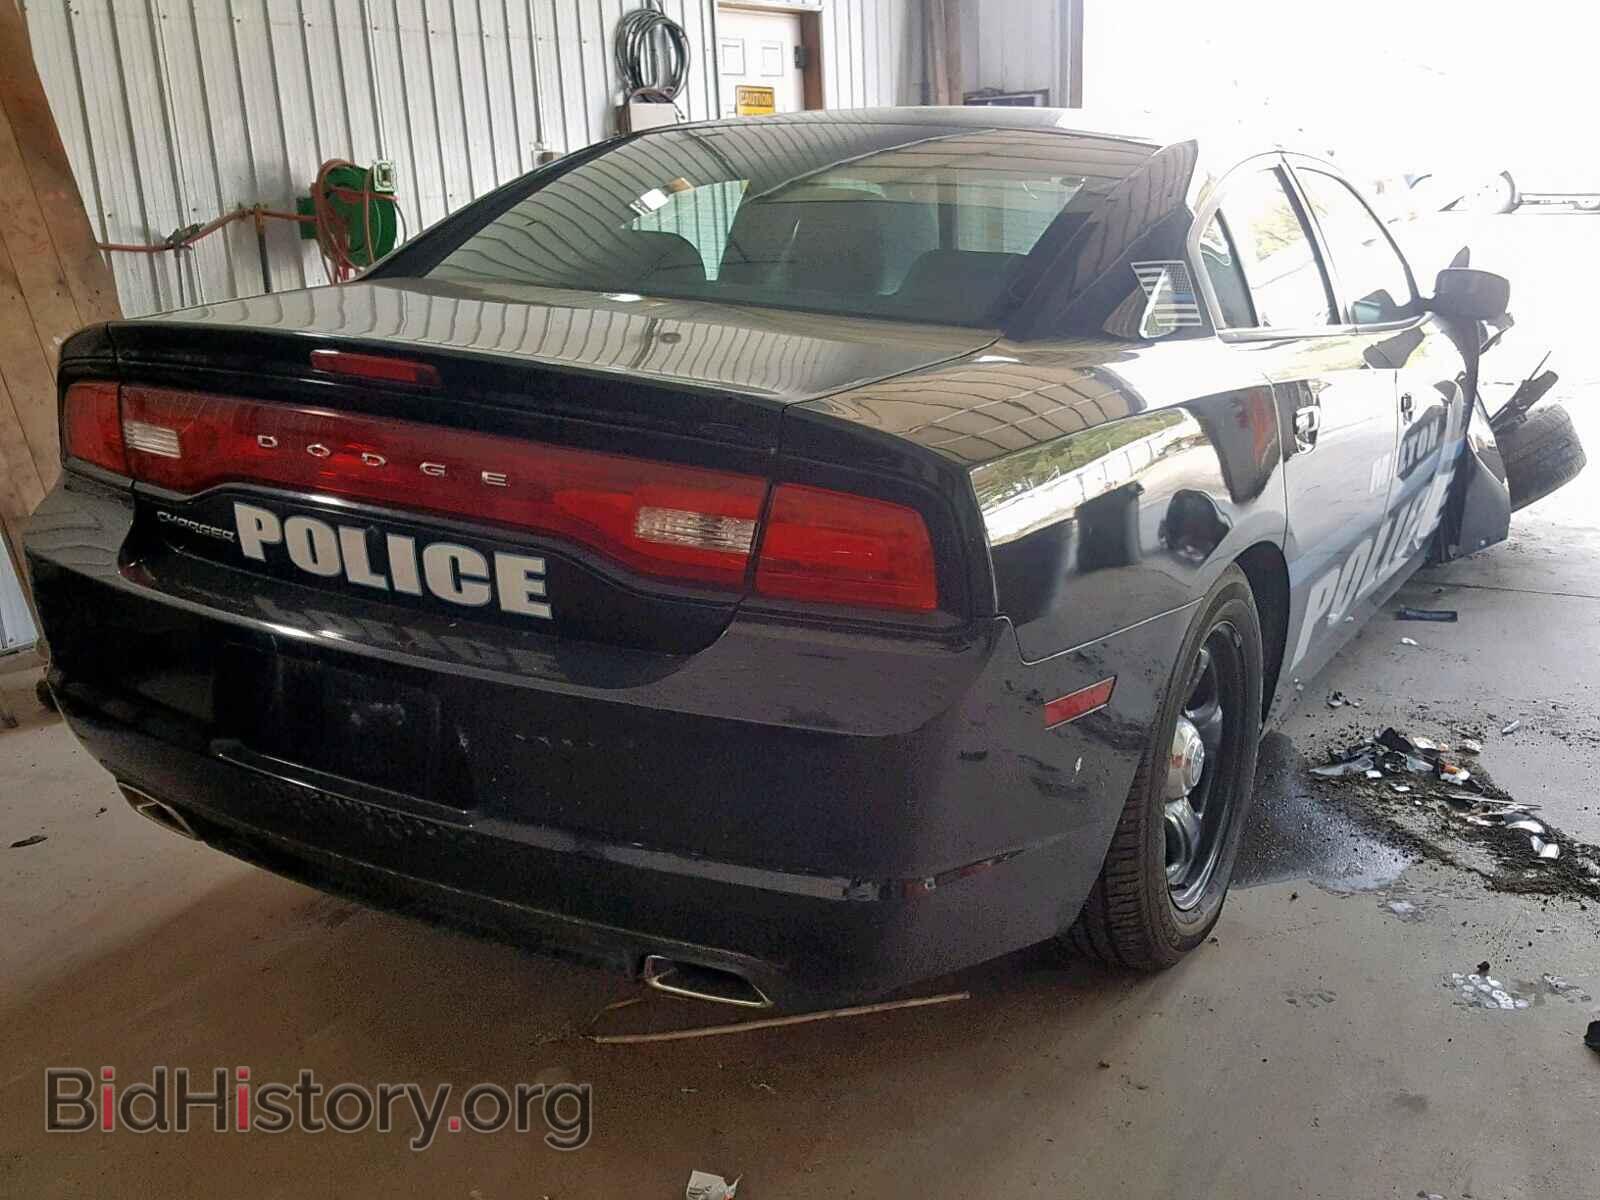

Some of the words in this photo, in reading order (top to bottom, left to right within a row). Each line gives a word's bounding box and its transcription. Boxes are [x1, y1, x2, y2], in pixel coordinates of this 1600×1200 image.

[740, 91, 772, 105] CAUTION
[257, 435, 508, 487] DODGE
[157, 511, 236, 543] CHARGER
[233, 503, 553, 620] POLICE
